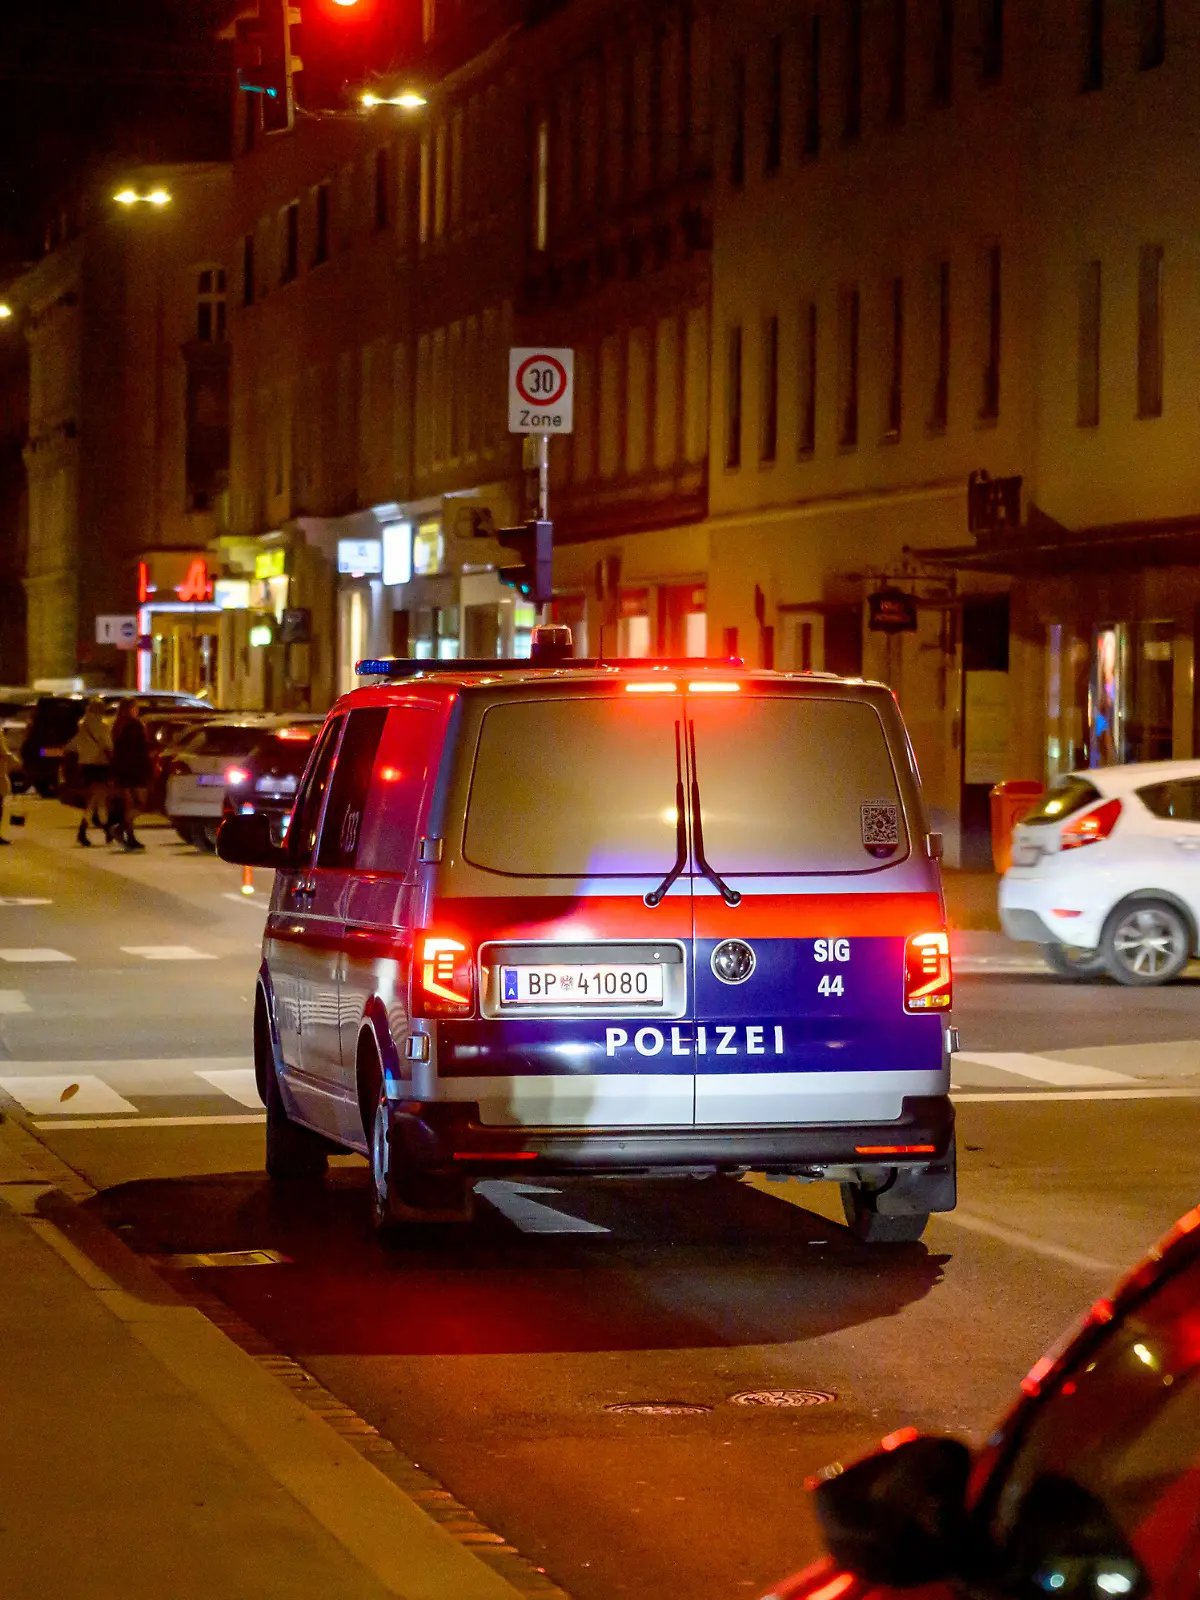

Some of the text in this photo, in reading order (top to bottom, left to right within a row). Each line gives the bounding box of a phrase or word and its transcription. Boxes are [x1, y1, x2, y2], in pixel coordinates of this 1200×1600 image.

[529, 368, 553, 393] 30
[519, 410, 562, 427] Zone
[813, 939, 850, 962] SIG
[507, 987, 516, 996] A
[528, 972, 648, 995] BP 41080
[817, 975, 845, 997] 44
[605, 1025, 784, 1057] POLIZEI
